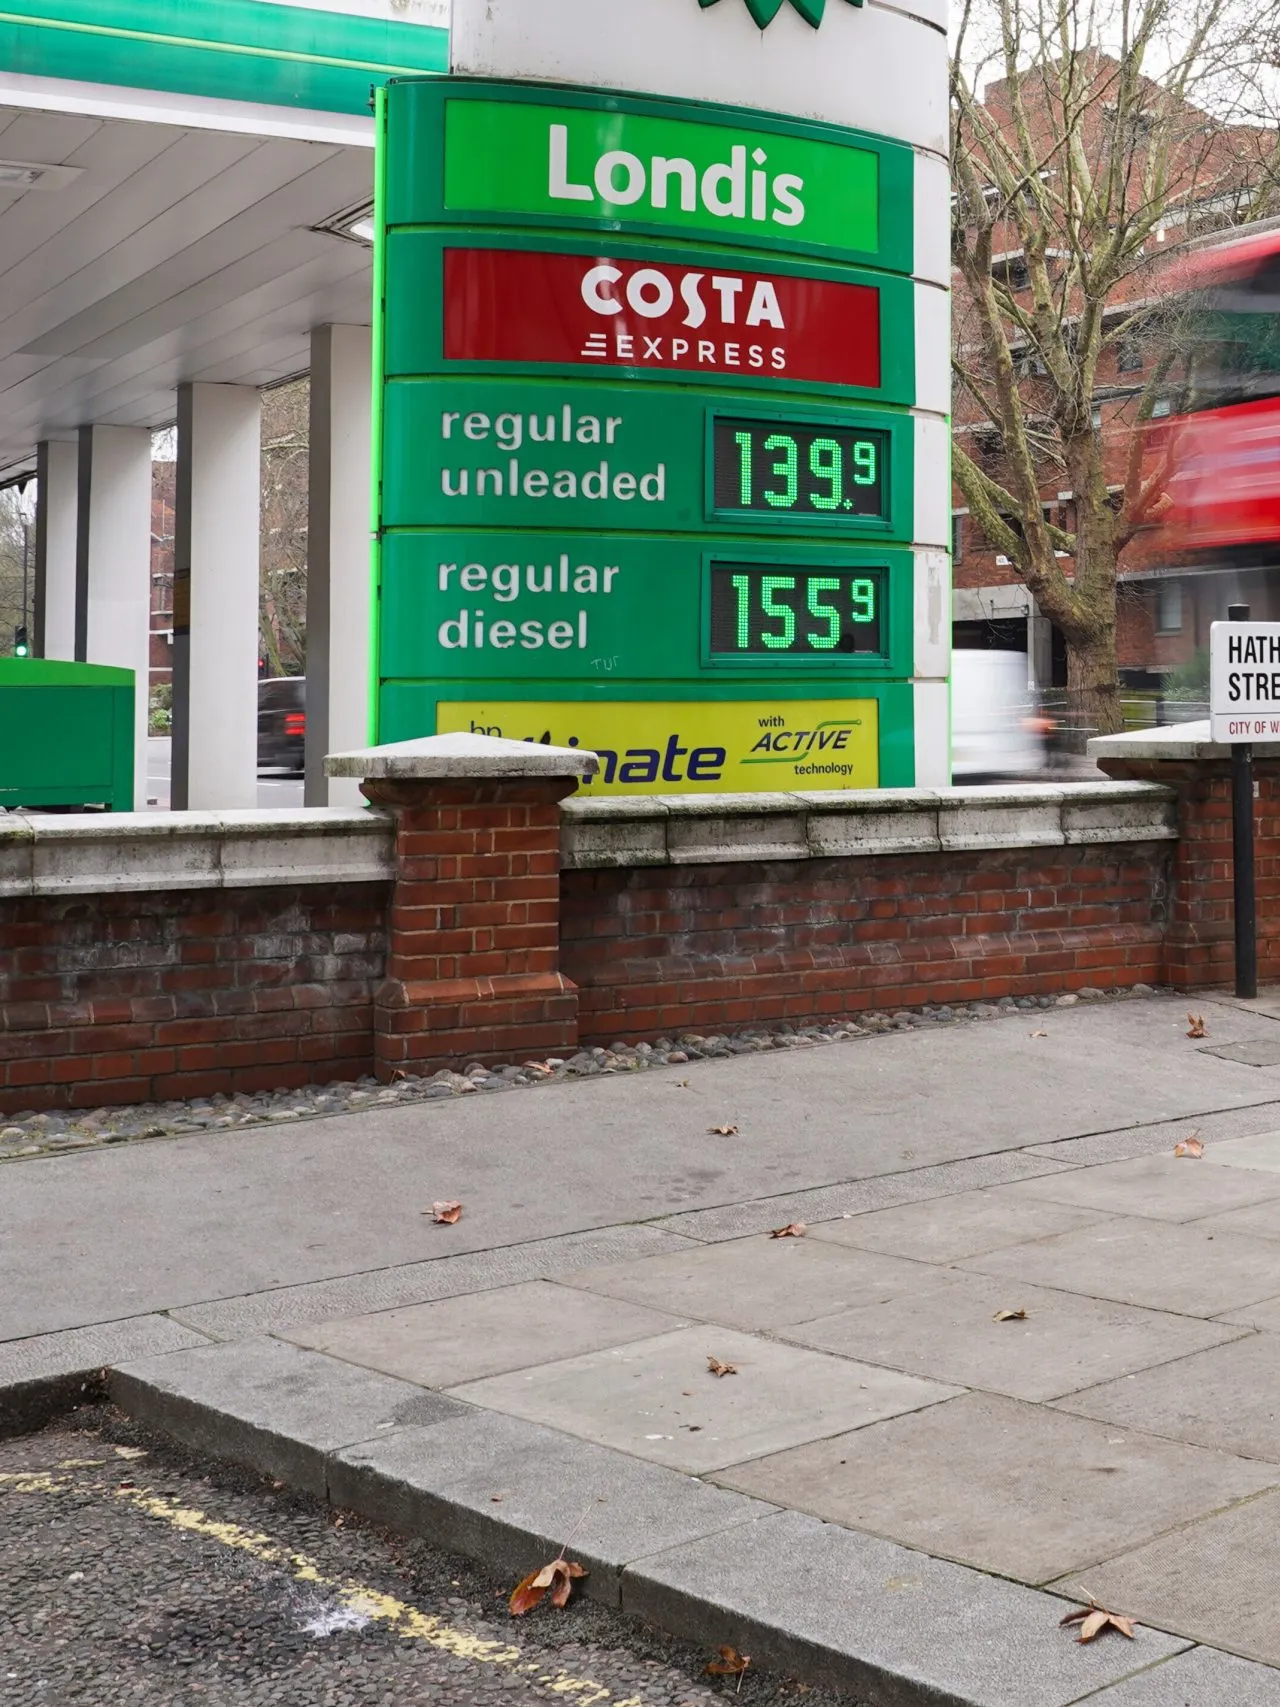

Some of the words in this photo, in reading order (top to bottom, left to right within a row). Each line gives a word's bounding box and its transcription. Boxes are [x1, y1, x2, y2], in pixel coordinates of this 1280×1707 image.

[548, 124, 805, 227] Londis
[580, 265, 785, 329] COSTA
[616, 334, 787, 370] EXPRESS
[441, 404, 622, 450] regular
[441, 458, 666, 501] unleaded
[437, 553, 620, 602] regular
[437, 609, 588, 649] diesel
[750, 729, 852, 753] ACTIVE
[758, 715, 785, 728] with
[1229, 721, 1251, 735] CITY
[1254, 720, 1267, 734] OF
[794, 762, 854, 776] technology
